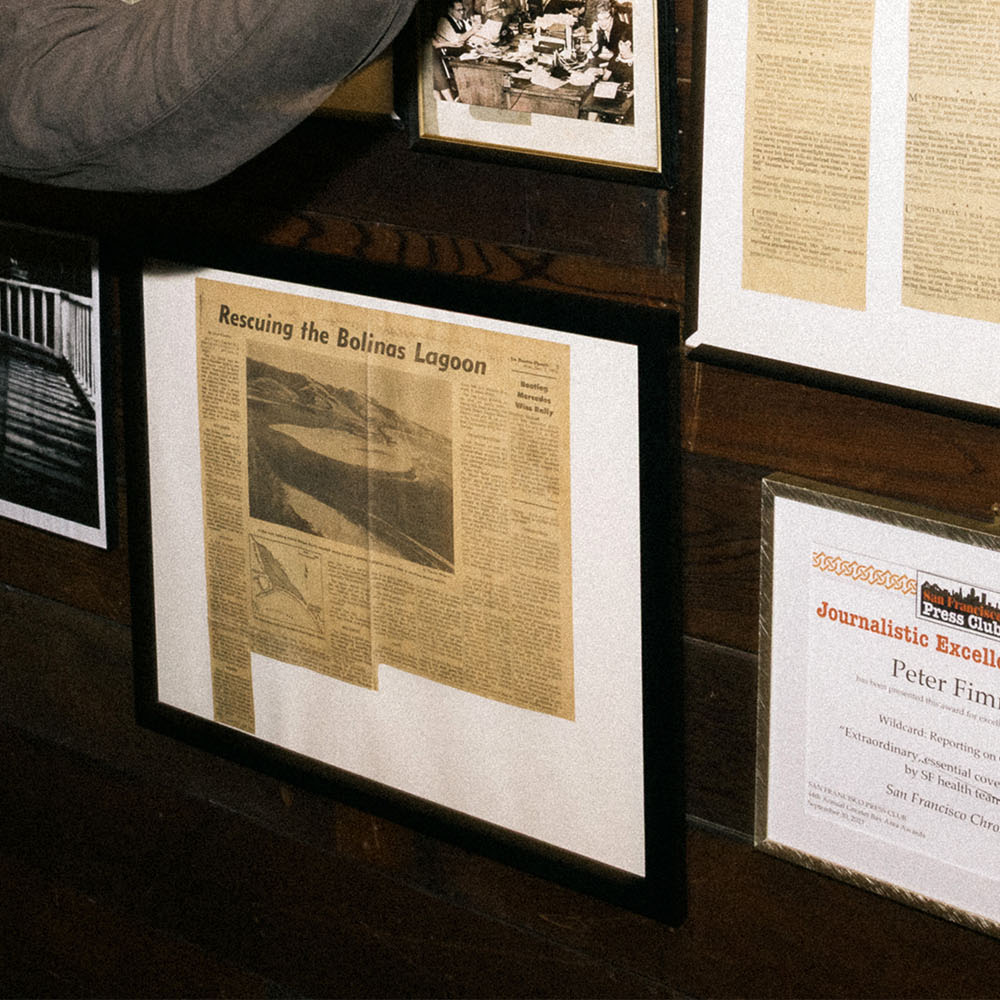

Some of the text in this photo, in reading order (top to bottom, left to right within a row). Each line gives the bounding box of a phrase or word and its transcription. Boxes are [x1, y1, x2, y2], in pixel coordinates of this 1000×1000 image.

[218, 304, 294, 340] Rescuing
[300, 321, 329, 345] the
[337, 327, 407, 360] Bolinas
[414, 342, 488, 376] Lagoon
[923, 588, 945, 606] San
[816, 601, 929, 648] Journalistic
[922, 601, 1000, 637] Press Club
[888, 685, 924, 703] presented
[940, 702, 965, 716] award
[966, 710, 978, 721] for
[891, 658, 1000, 711] Peter Fim
[879, 713, 997, 762] Wildcard: Reporting on
[904, 764, 918, 778] by
[920, 770, 935, 782] SF
[937, 776, 973, 796] health
[922, 756, 972, 779] essential
[808, 781, 907, 821] SAN FRANCISCO PRESS CLUB
[808, 799, 840, 816] September
[823, 796, 845, 809] Annual
[870, 813, 882, 823] Bay
[884, 816, 899, 829] Area
[900, 824, 926, 838] Awards
[886, 783, 908, 801] San
[911, 792, 967, 822] Francisco
